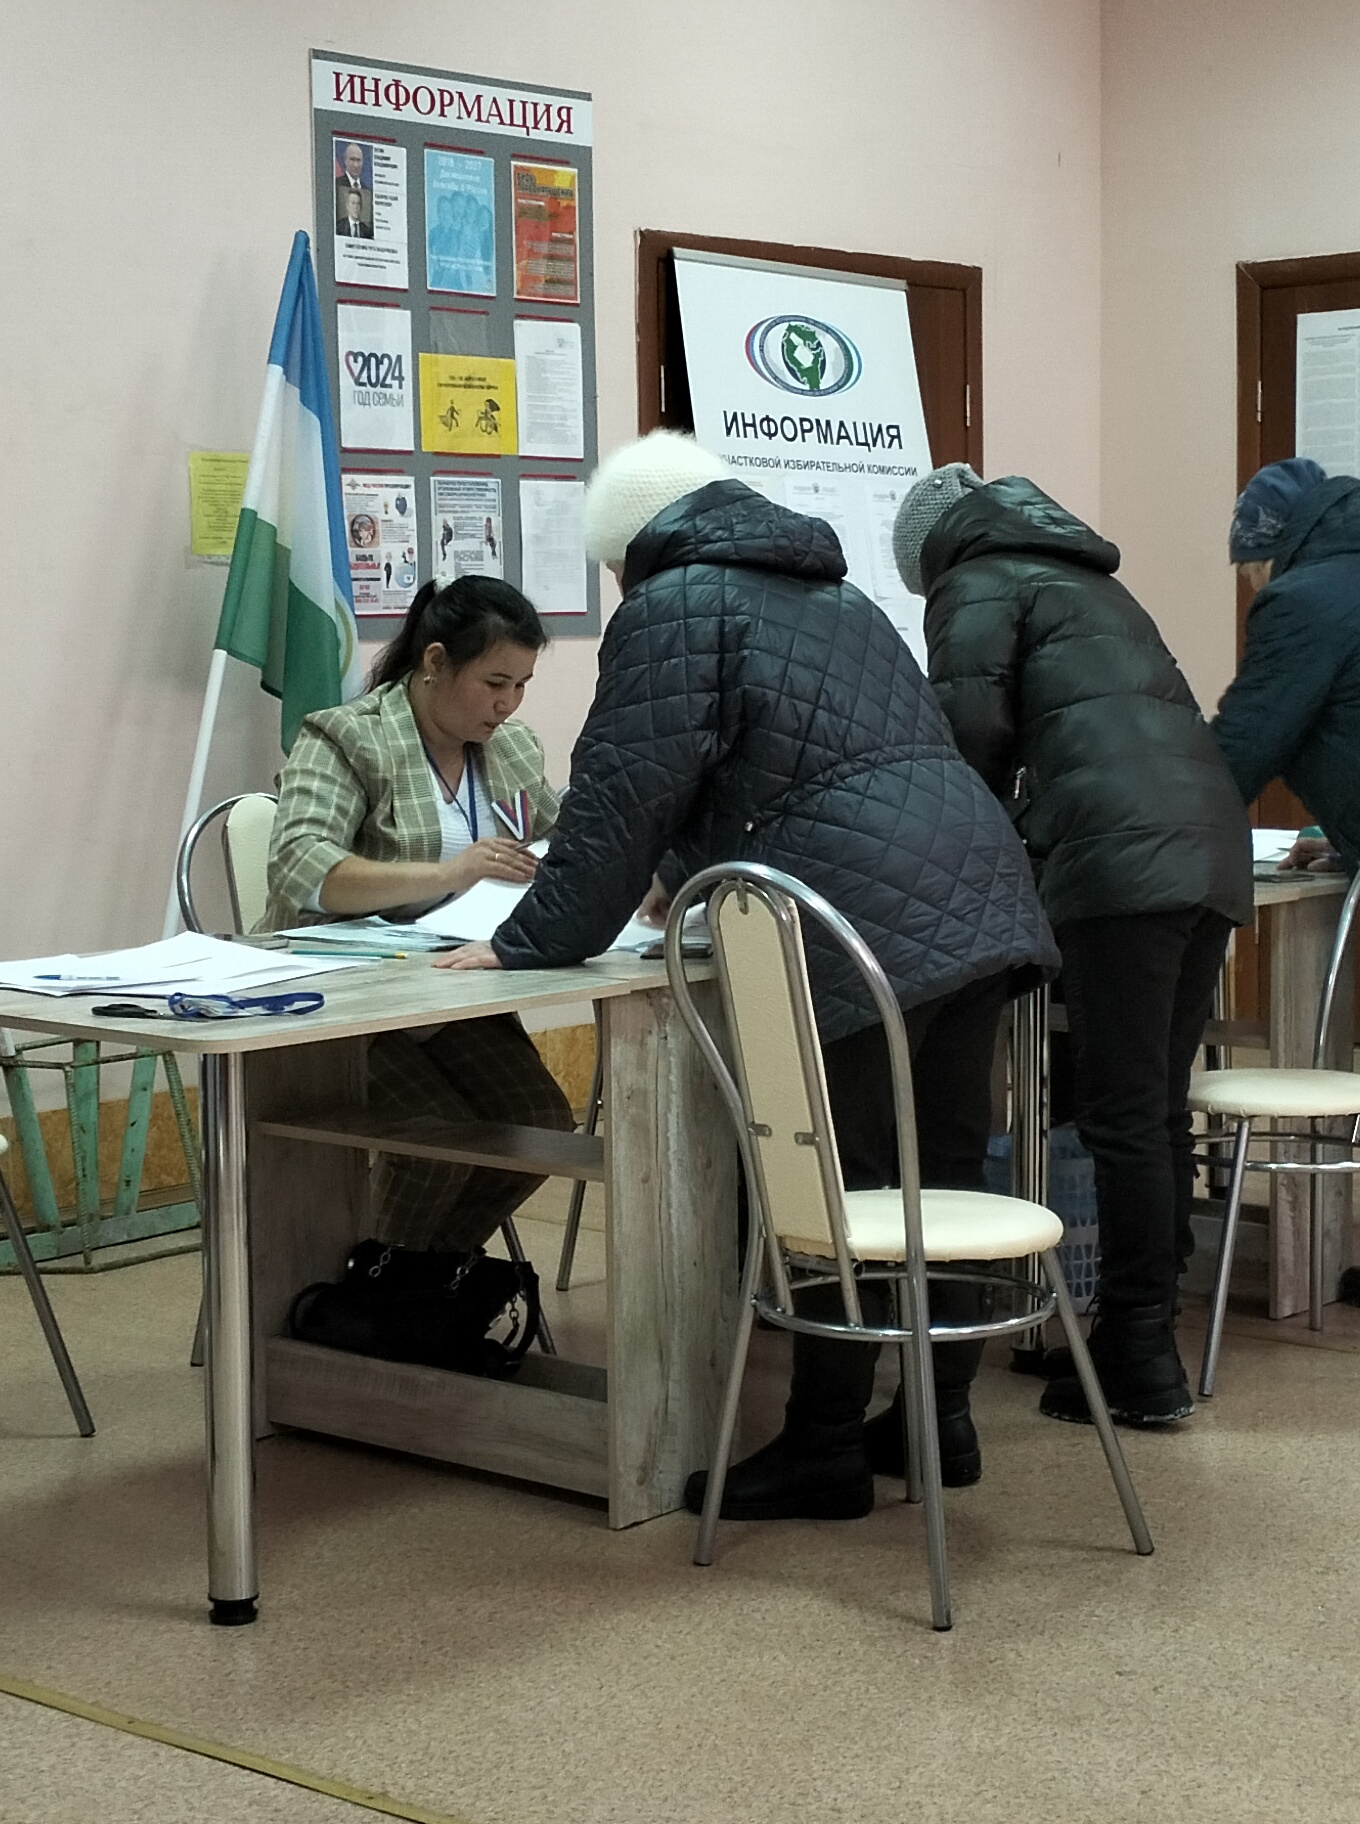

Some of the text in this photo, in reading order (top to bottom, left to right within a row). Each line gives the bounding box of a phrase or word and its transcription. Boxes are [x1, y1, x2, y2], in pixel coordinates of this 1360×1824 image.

[332, 71, 574, 136] ИНФОРМАЦИЯ
[352, 351, 405, 390] 2024
[353, 390, 405, 408] ГОД СЕМЬИ
[723, 410, 903, 453] ИНФОРМАЦИЯ
[783, 459, 865, 474] ИЗБИРАТЕЛЬНОЙ
[867, 463, 918, 477] КОМИССИИ
